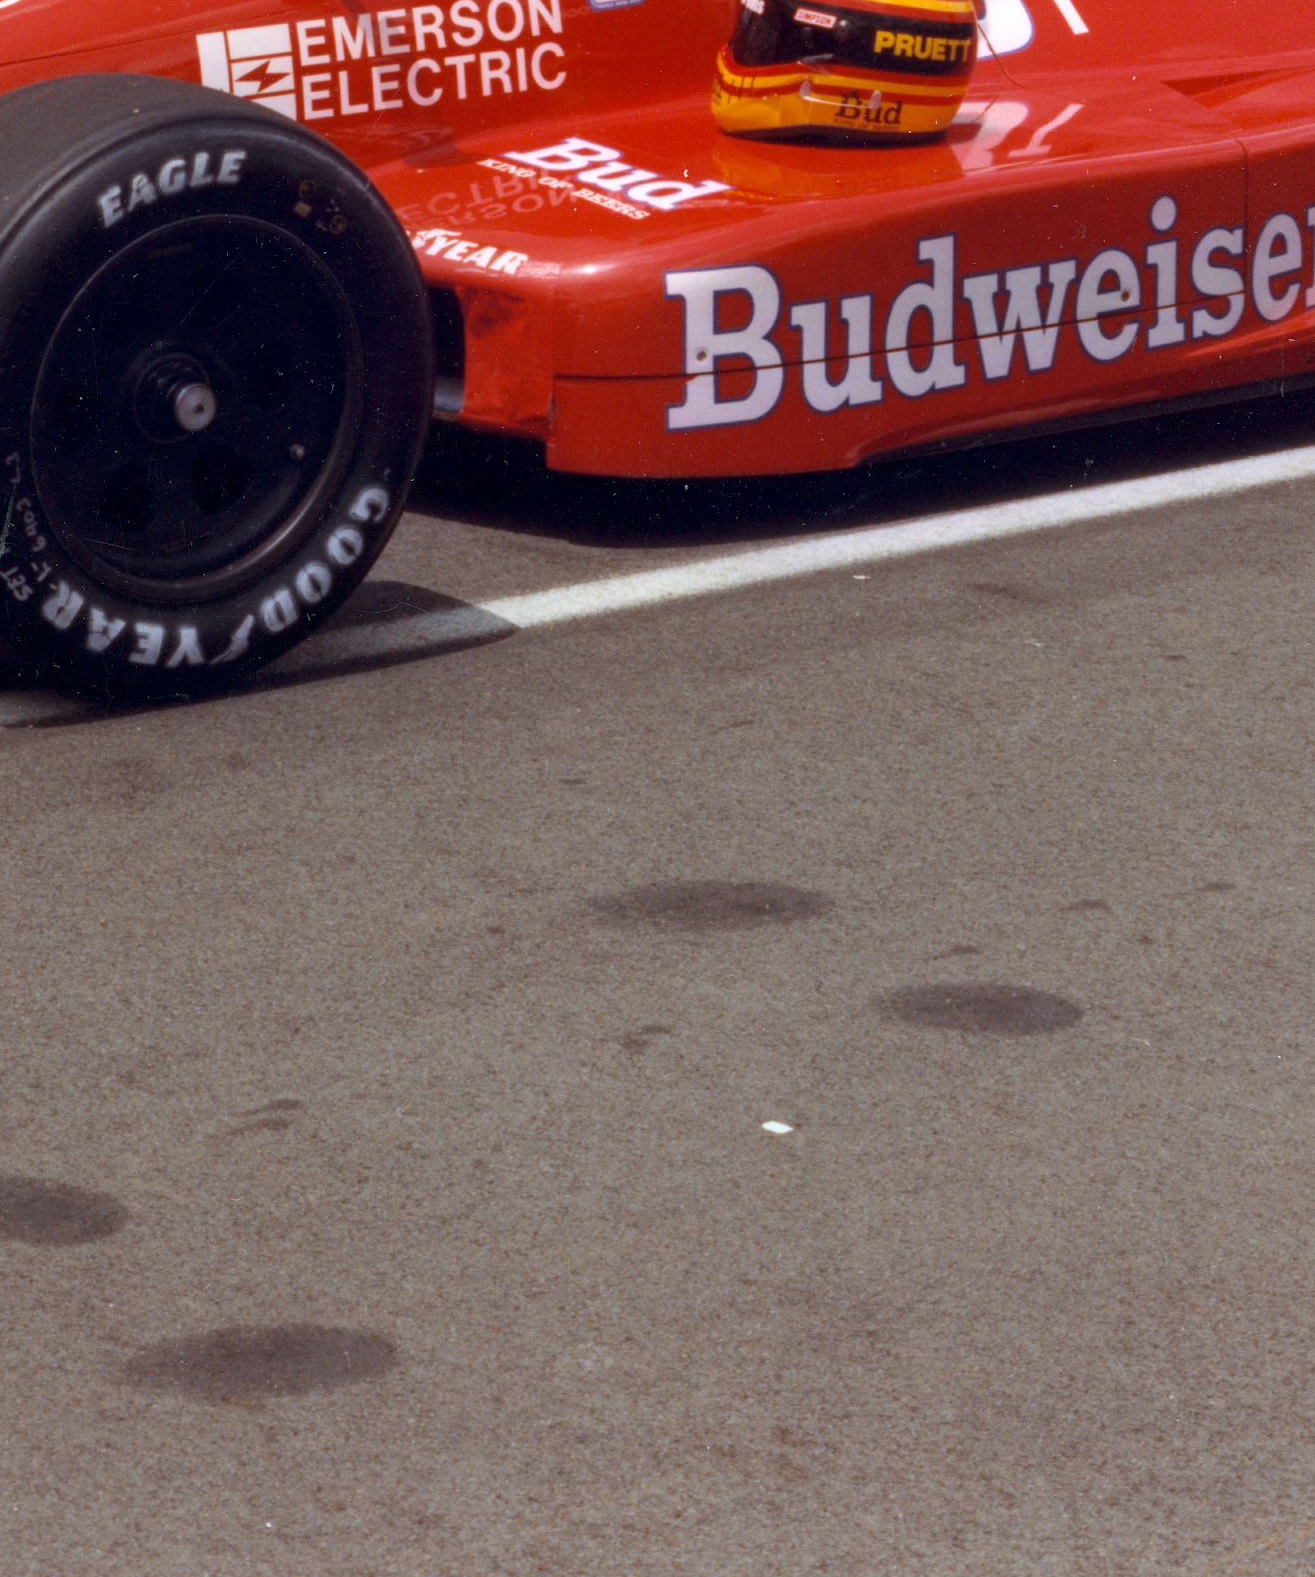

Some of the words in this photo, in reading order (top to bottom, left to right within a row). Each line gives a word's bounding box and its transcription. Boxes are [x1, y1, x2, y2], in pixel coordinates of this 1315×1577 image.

[797, 10, 832, 27] SIMPSON
[874, 31, 971, 62] PRUETT
[301, 41, 567, 121] ELECTRIC
[834, 89, 903, 125] Bud
[96, 150, 247, 228] EAGLE
[477, 159, 537, 178] KING
[538, 177, 574, 190] OF
[572, 188, 651, 220] BEERS
[499, 137, 737, 213] Bud
